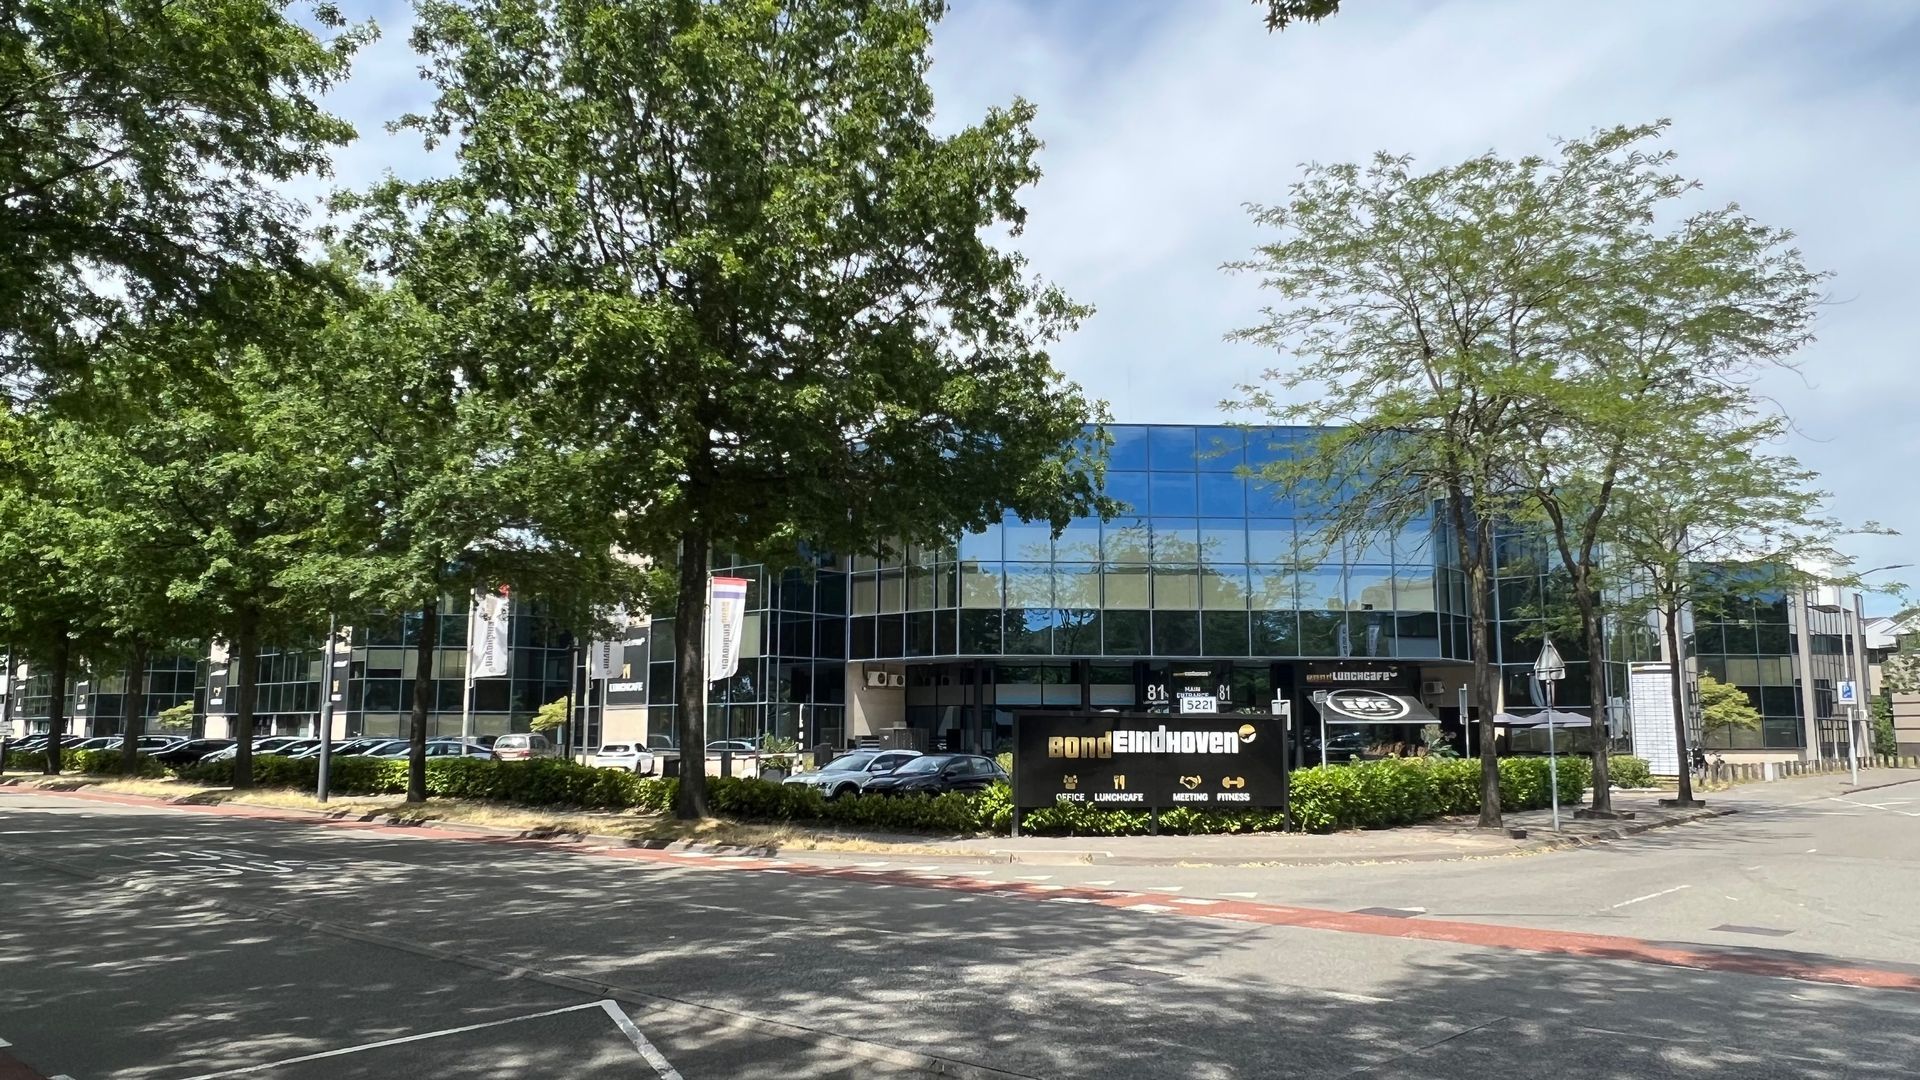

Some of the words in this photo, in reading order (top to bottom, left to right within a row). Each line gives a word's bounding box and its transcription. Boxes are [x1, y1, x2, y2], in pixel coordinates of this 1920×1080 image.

[1147, 684, 1164, 700] 81
[1219, 684, 1230, 700] 81
[1186, 700, 1213, 710] 5221
[1055, 792, 1085, 801] OFFICE
[1094, 792, 1144, 802] LUNCHCAFE
[1172, 792, 1209, 802] MEETING
[1216, 792, 1251, 802] FITNESS
